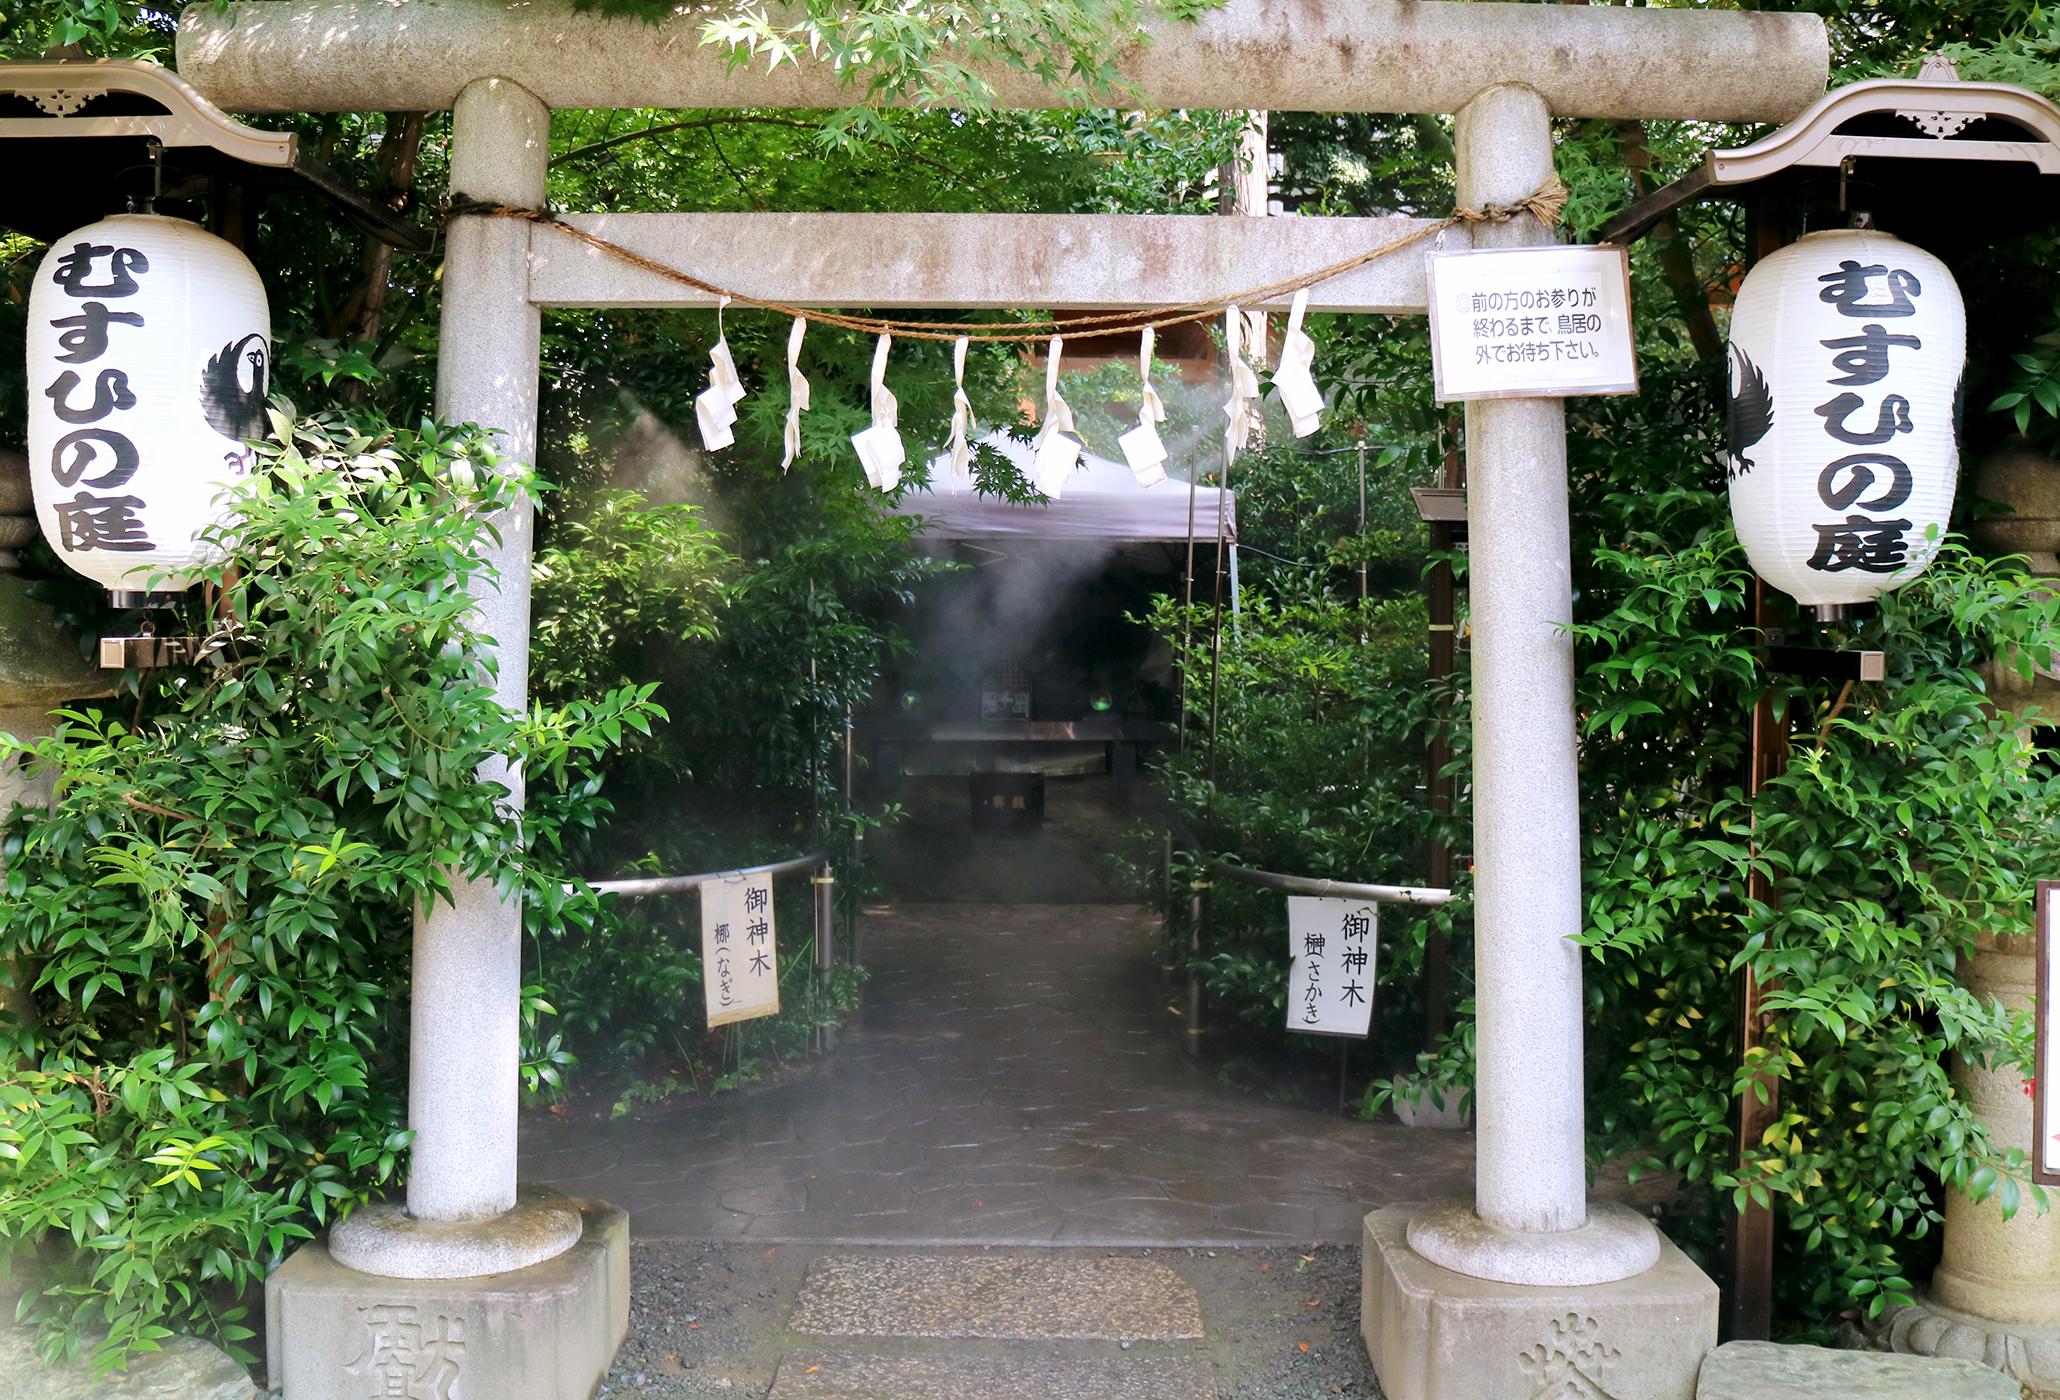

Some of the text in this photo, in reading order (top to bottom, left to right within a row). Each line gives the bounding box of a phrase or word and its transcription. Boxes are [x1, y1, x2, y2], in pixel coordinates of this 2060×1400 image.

[45, 242, 156, 552] むすひの庭
[1475, 340, 1600, 365] 外でお待ち下さい。
[1806, 260, 1921, 573] むすひの庭
[744, 887, 771, 977] 御神木
[1340, 913, 1370, 1008] 御神木
